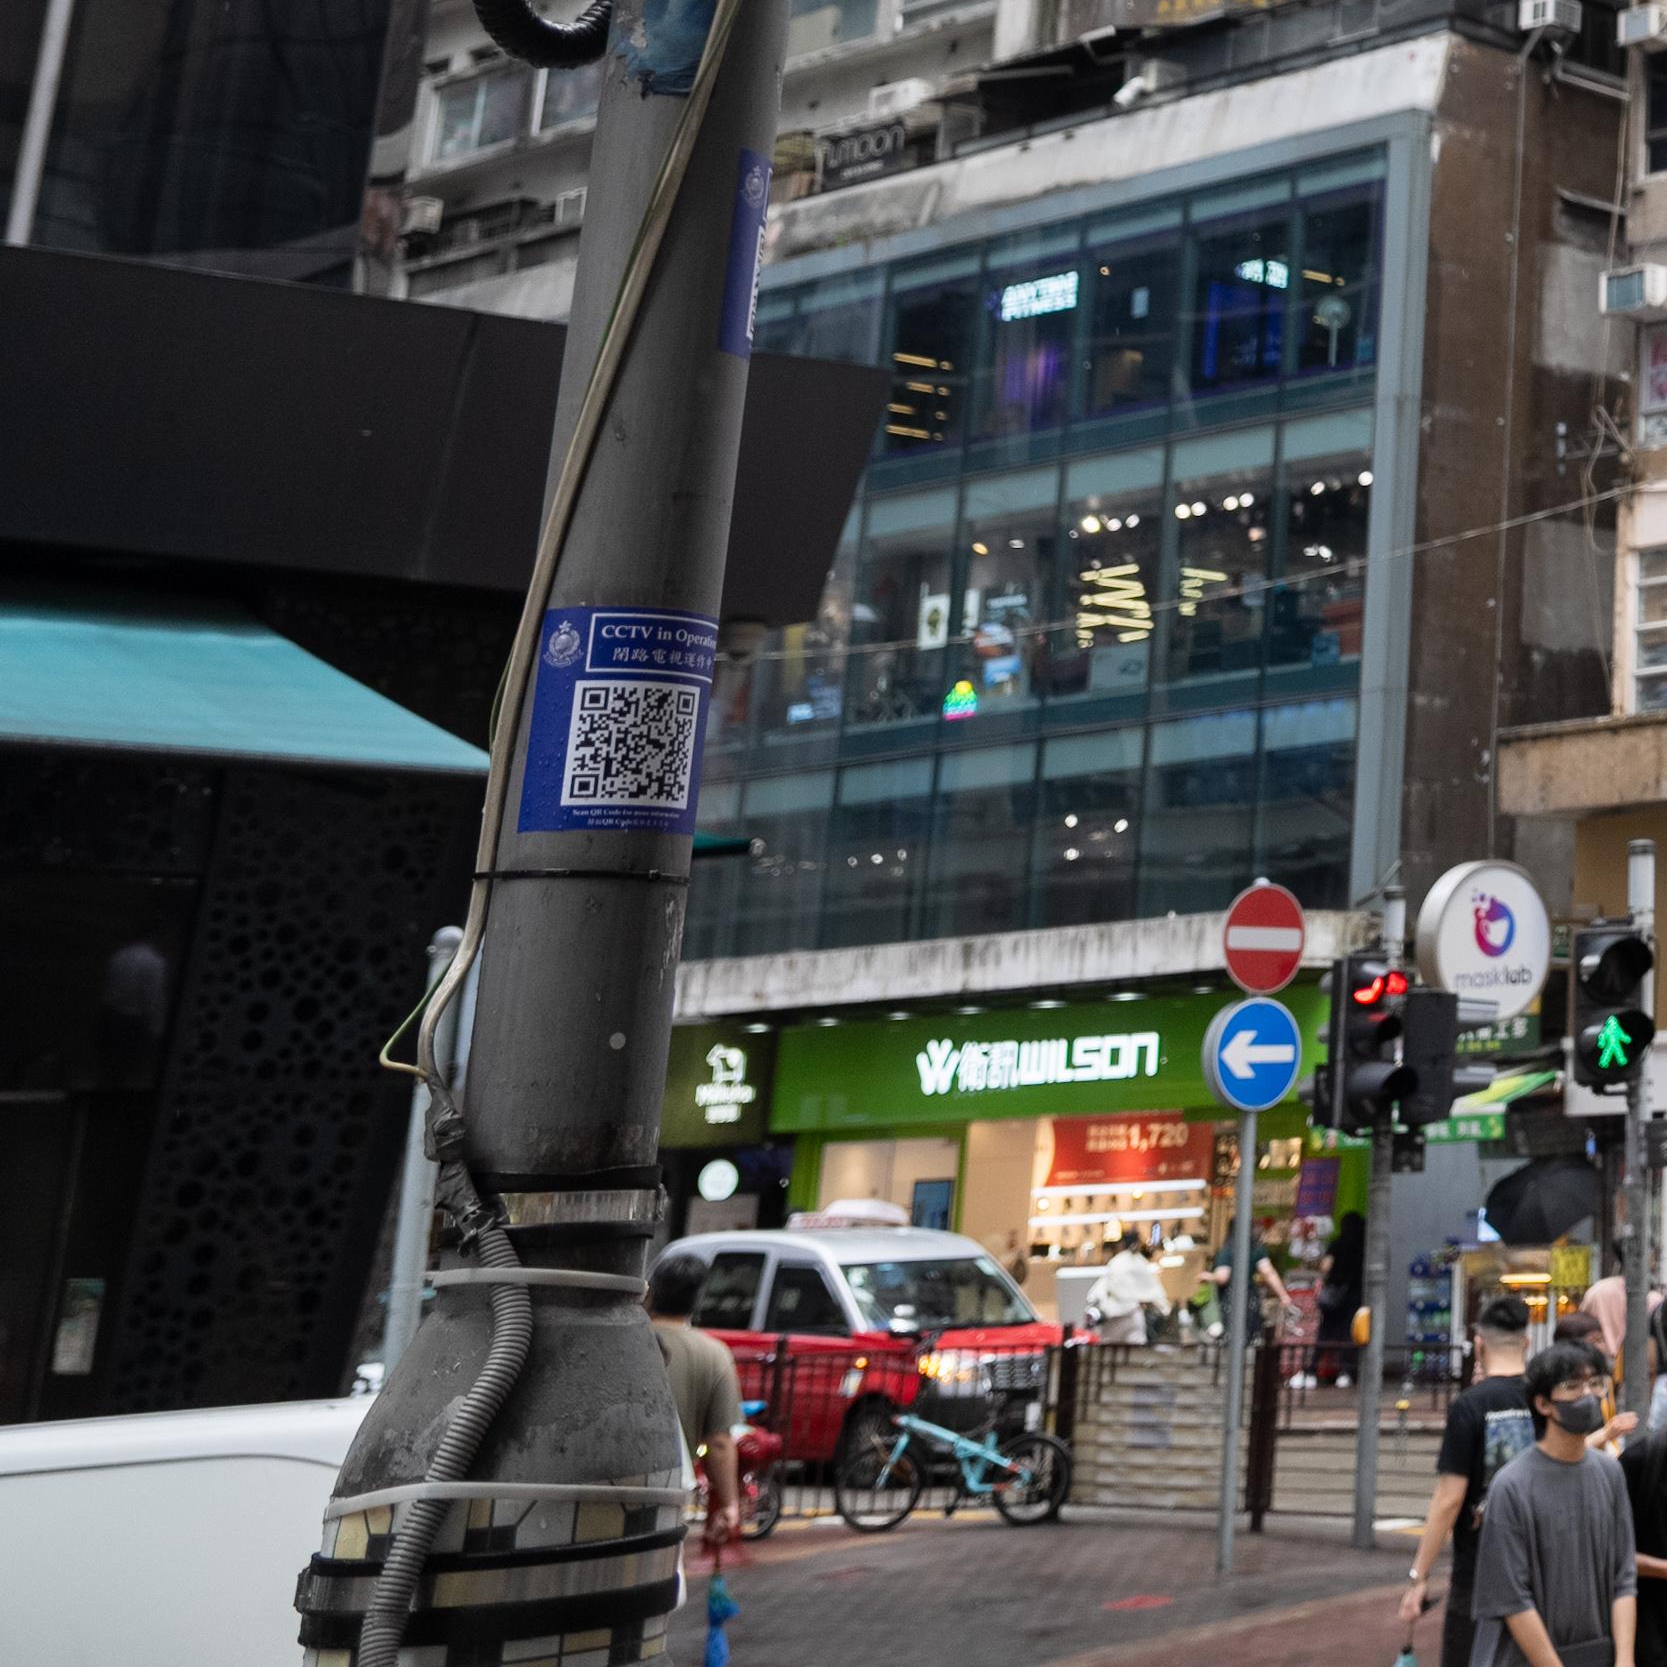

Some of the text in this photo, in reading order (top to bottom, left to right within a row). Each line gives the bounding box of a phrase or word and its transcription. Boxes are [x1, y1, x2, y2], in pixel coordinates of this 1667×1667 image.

[601, 624, 653, 639] CCTV
[657, 626, 672, 640] in
[1019, 1031, 1160, 1086] WILSON
[1127, 1121, 1188, 1153] 1,720
